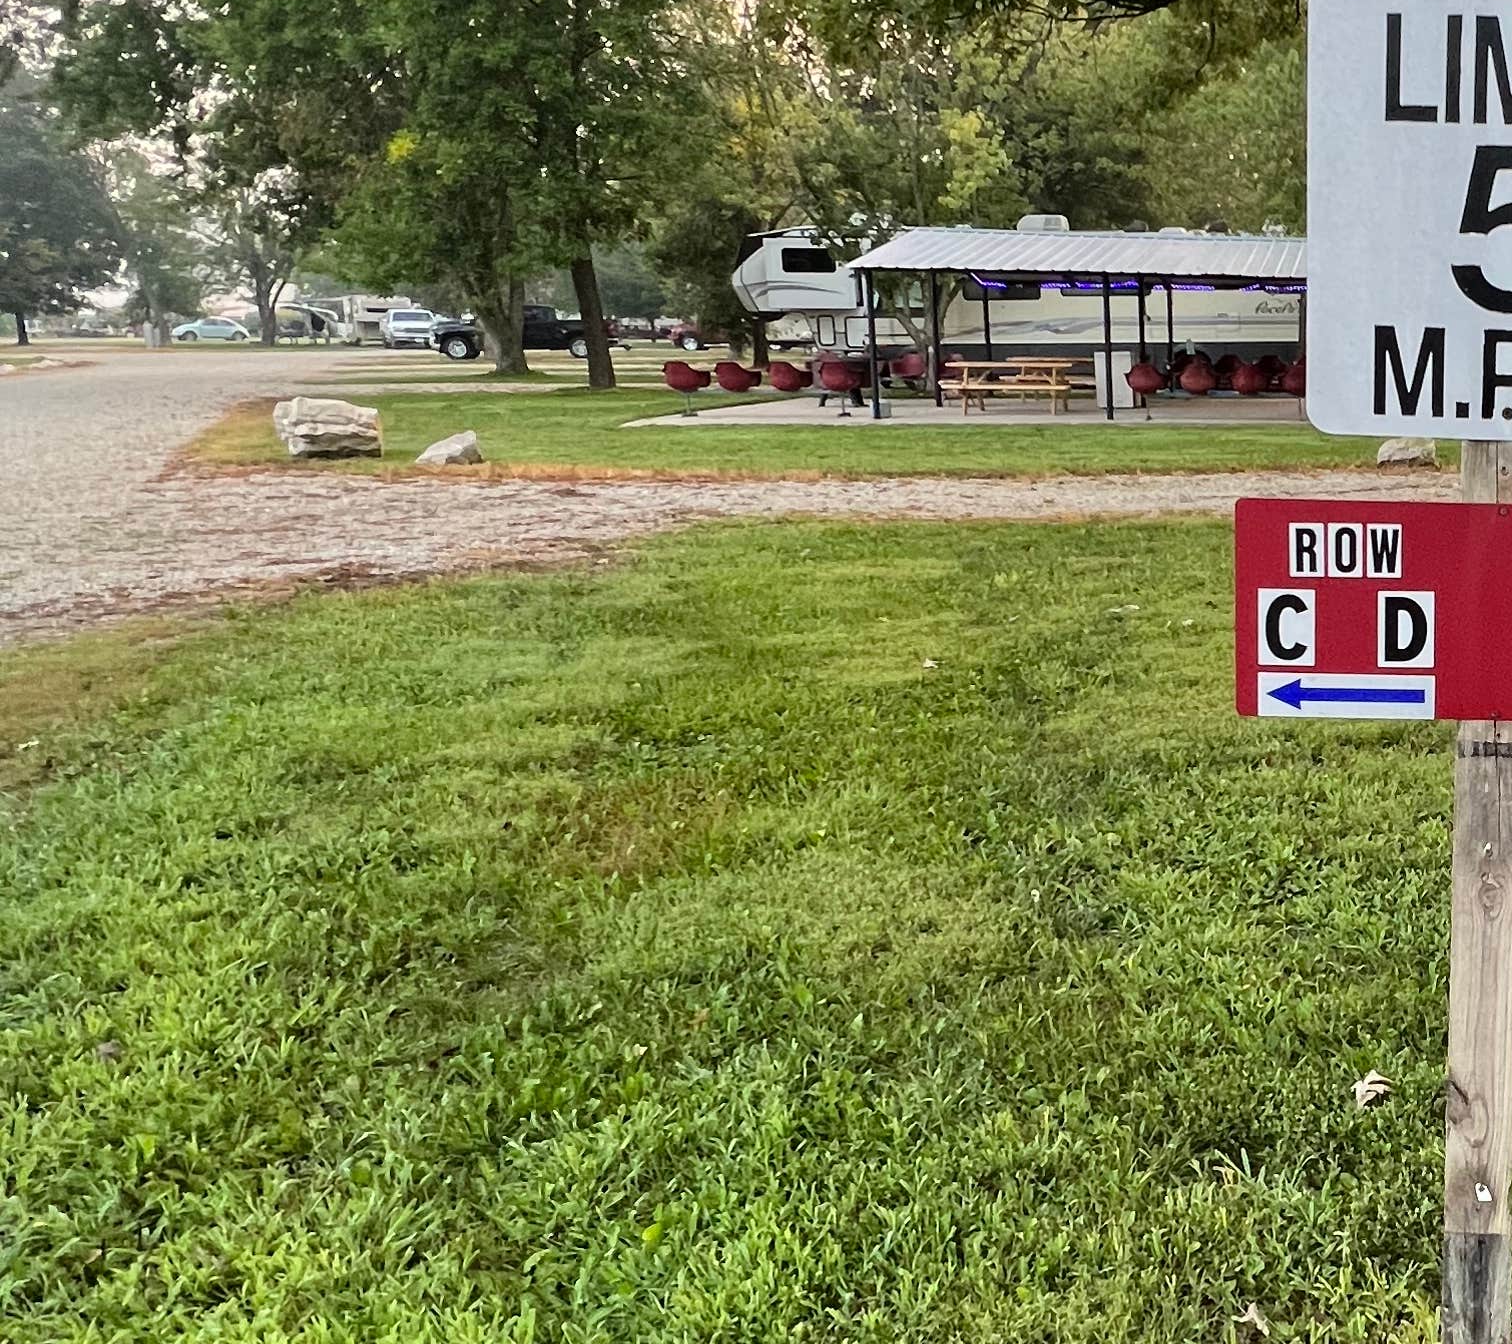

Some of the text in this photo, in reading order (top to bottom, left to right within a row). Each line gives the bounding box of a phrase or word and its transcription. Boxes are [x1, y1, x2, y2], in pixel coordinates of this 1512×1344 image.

[1295, 526, 1400, 574] ROW
[1264, 593, 1428, 663] C D
